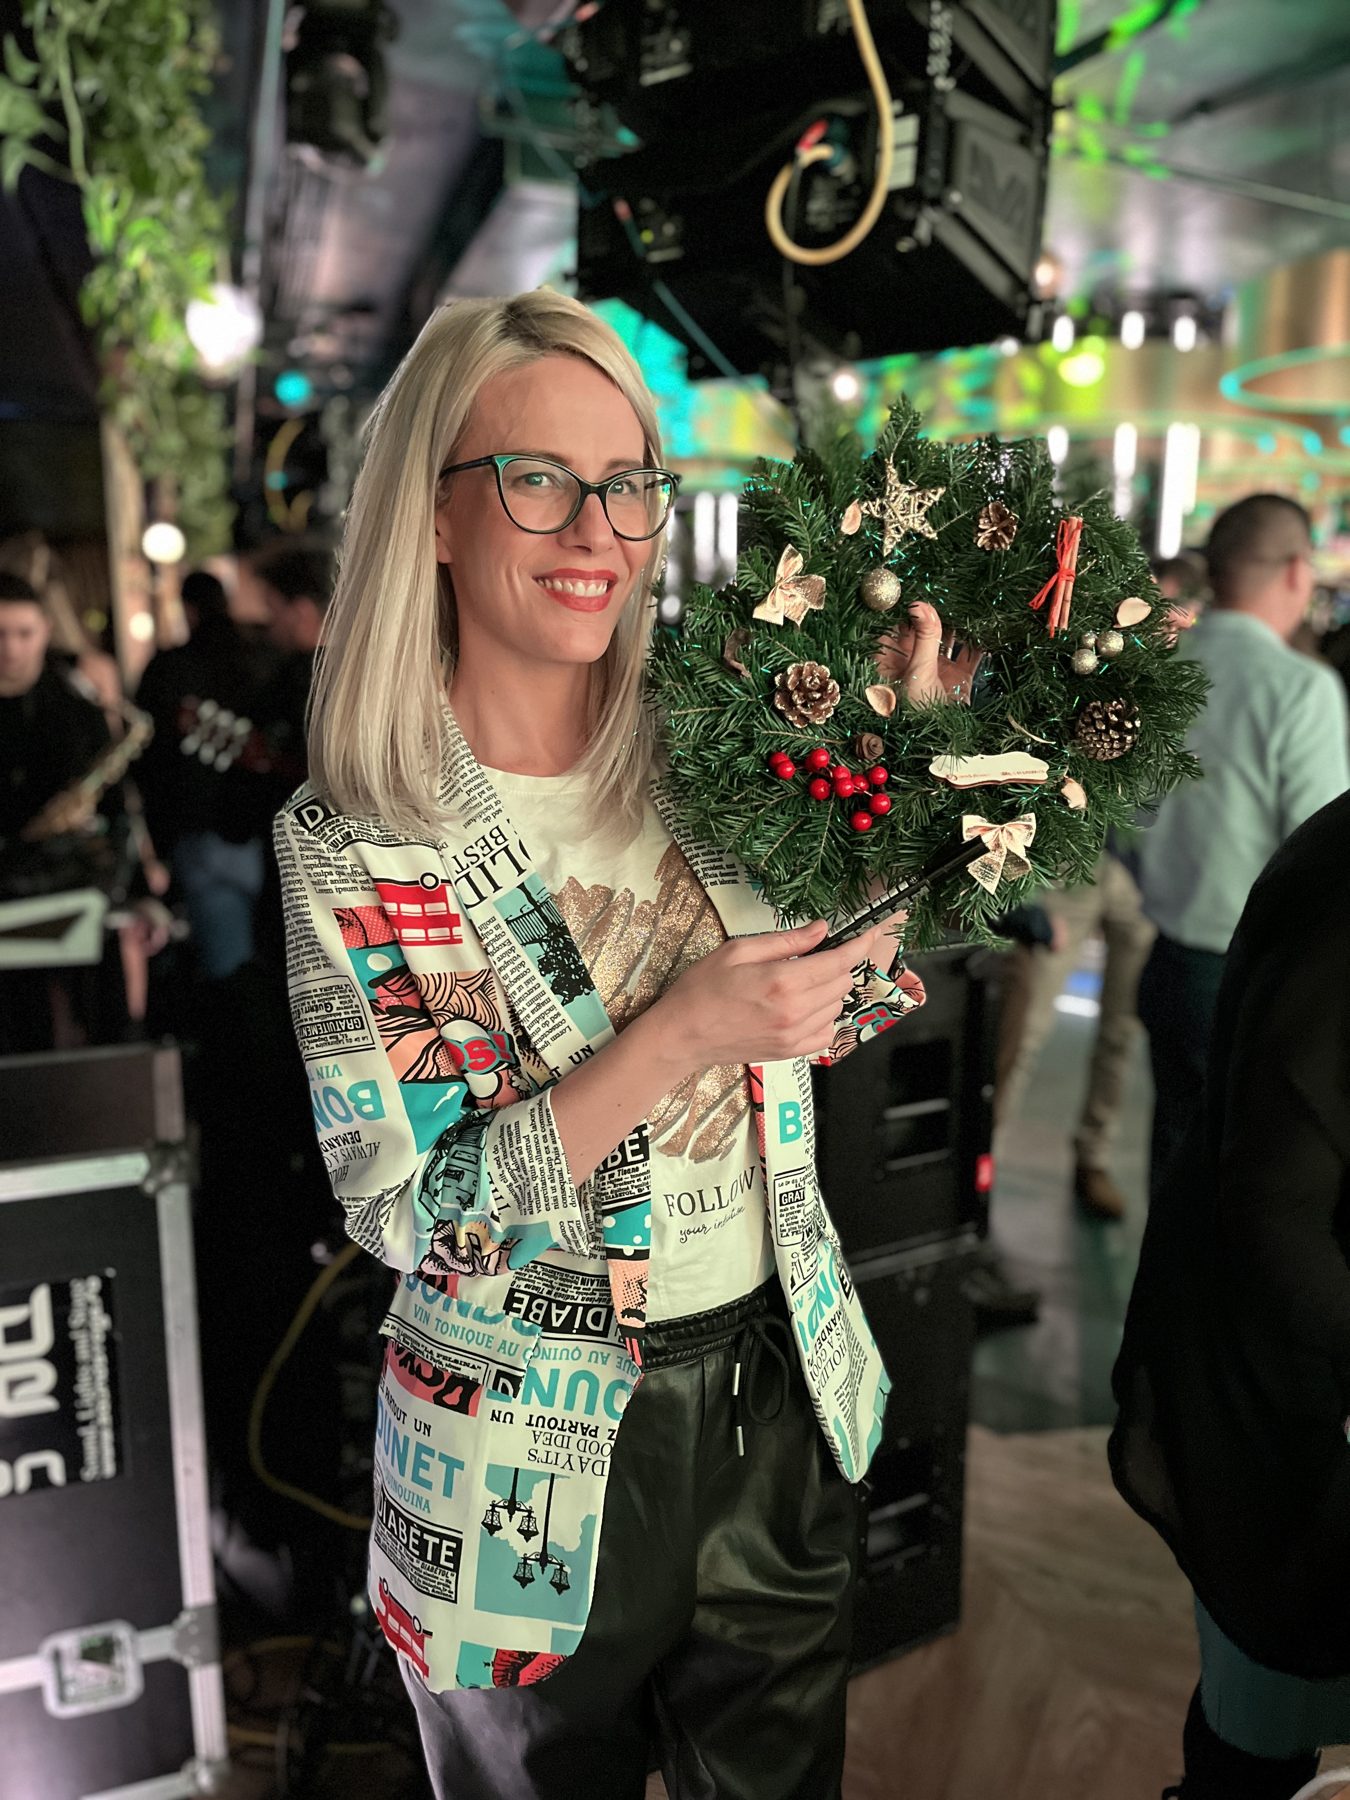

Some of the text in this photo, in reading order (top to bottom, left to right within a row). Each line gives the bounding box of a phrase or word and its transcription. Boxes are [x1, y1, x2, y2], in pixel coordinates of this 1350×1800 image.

[452, 825, 509, 874] BEST
[335, 885, 359, 895] ipsum
[510, 960, 526, 974] dolor
[526, 989, 547, 1008] minim
[531, 996, 552, 1016] magna
[526, 1004, 558, 1030] incididunt
[551, 1025, 571, 1044] Lorem
[568, 1044, 595, 1066] UN
[523, 1134, 534, 1164] nostrud
[529, 1107, 550, 1212] exercitation ullamco laboris
[553, 1147, 562, 1167] Duis
[545, 1156, 556, 1185] aliquip
[532, 1183, 542, 1214] veniam,
[567, 1185, 577, 1208] dolor
[663, 1165, 756, 1217] FOLLOW
[781, 1189, 805, 1205] GRAT
[551, 1195, 560, 1210] nisi
[679, 1223, 712, 1244] your
[413, 1304, 431, 1326] VIN
[433, 1317, 495, 1350] TONIQUE
[496, 1340, 520, 1357] AU
[588, 1350, 611, 1365] AU
[413, 1417, 432, 1438] UN
[490, 1409, 515, 1425] UN
[525, 1414, 600, 1438] PARTOUT
[532, 1430, 614, 1458] OOD IDEA
